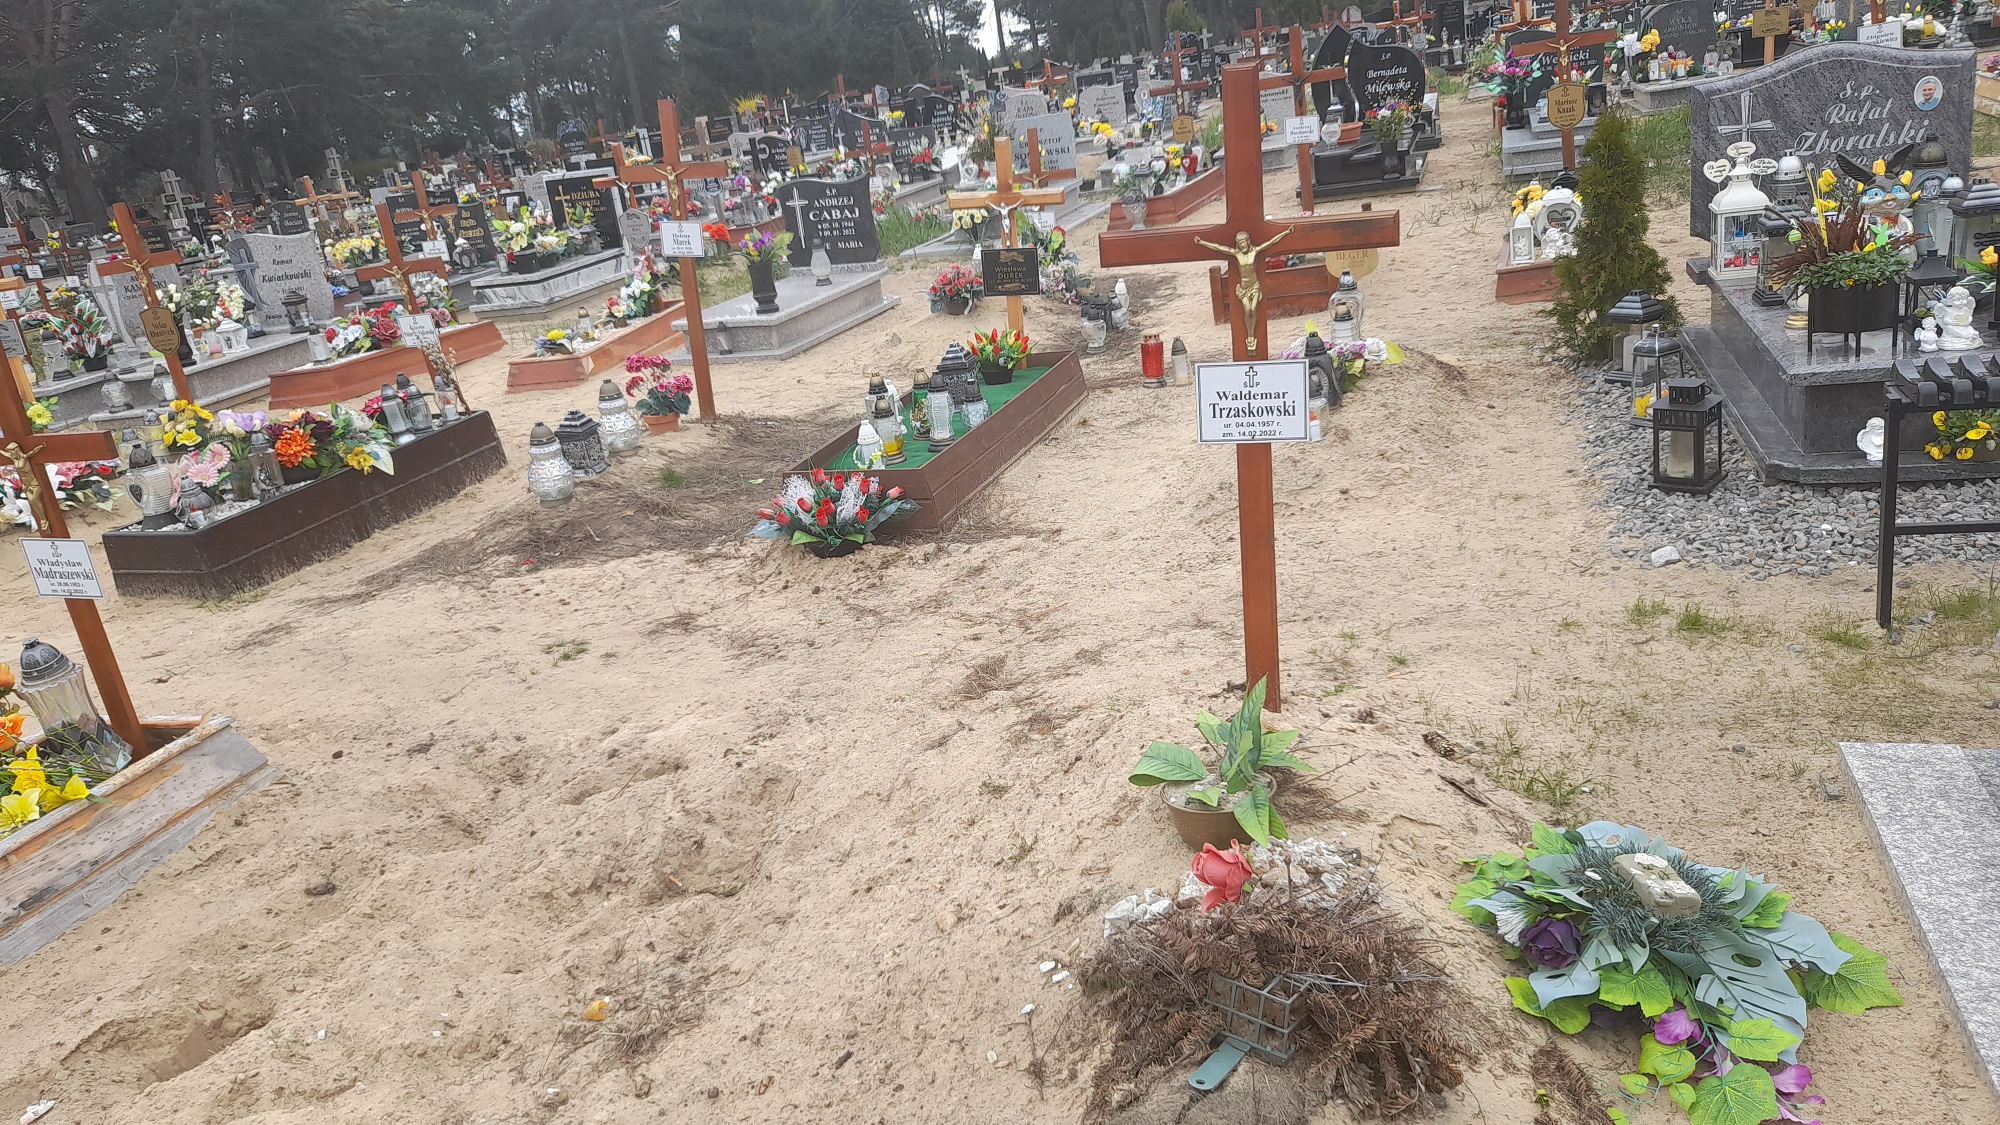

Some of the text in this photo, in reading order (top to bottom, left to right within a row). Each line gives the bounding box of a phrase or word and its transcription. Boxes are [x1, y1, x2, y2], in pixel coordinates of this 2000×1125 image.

[1366, 64, 1408, 79] Bernadeta
[1364, 77, 1411, 95] Milewska
[1554, 98, 1578, 106] Mariusz
[1557, 106, 1576, 115] Knaak
[1825, 99, 1893, 126] Rafał
[1795, 119, 1930, 156] Zboralski
[813, 196, 854, 208] ANDRZEJ
[809, 207, 860, 221] CABAJ
[838, 240, 864, 249] MARIA
[1335, 249, 1369, 261] BEGER
[272, 258, 293, 266] Roman
[262, 269, 312, 284] Kwiatkowski
[123, 280, 168, 293] KAMSKI
[1216, 390, 1289, 401] Waldemar
[1208, 400, 1296, 419] Trzaskowski
[1235, 421, 1275, 429] 04.04.1957
[1237, 430, 1277, 438] 14.02.2022
[37, 558, 83, 569] Władysław
[33, 567, 95, 582] Mądraszewski
